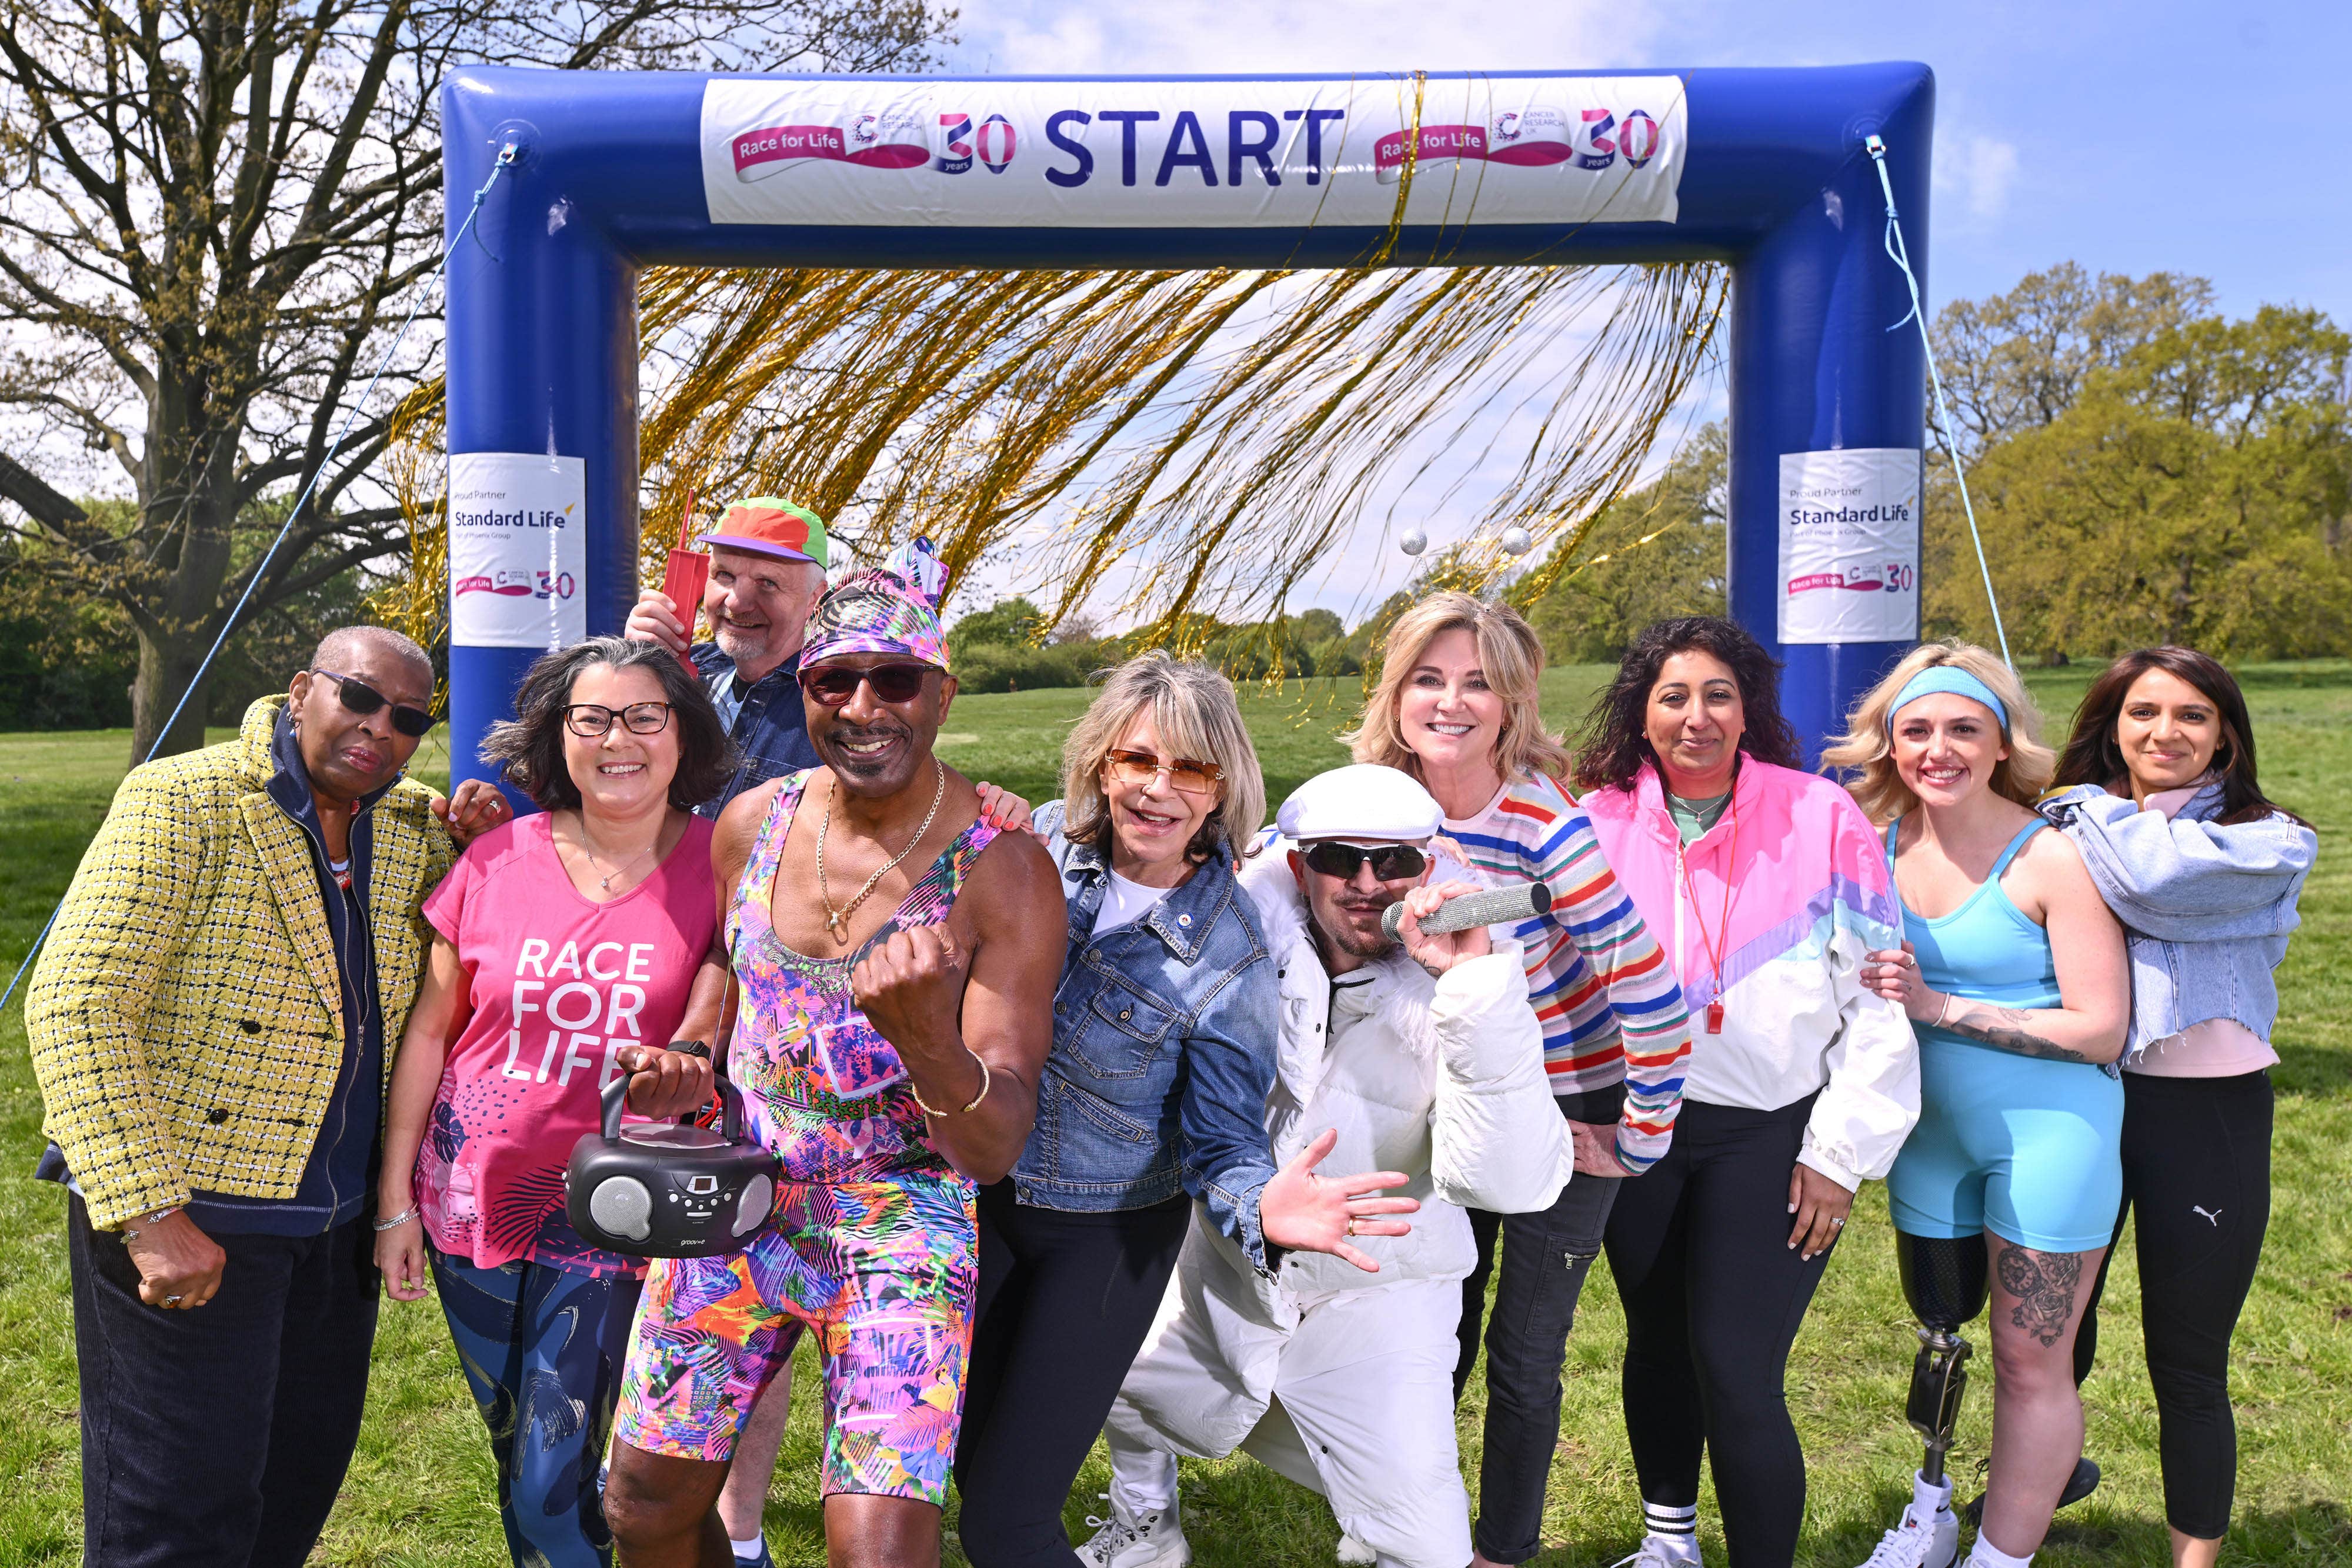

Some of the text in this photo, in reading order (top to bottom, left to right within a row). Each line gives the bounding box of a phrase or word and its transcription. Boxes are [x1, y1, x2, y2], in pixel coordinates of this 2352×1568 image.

[1524, 118, 1564, 128] RESEARCH
[740, 133, 839, 158] Race for Life
[935, 114, 1016, 175] 30
[1045, 109, 1345, 188] START
[1382, 141, 1420, 159] Rac
[1423, 134, 1447, 149] for
[1575, 109, 1659, 171] 30
[945, 161, 969, 171] years
[1586, 158, 1610, 167] years
[475, 491, 506, 499] Partner
[1790, 488, 1861, 498] Proud Partner
[455, 509, 565, 529] Standard Life
[1790, 505, 1909, 525] Standard Life
[491, 532, 511, 540] Group
[478, 579, 491, 588] Life
[1791, 579, 1810, 590] Race
[1811, 577, 1824, 585] for
[1885, 563, 1912, 593] 30
[515, 938, 655, 982] RACE
[512, 980, 646, 1037] FOR
